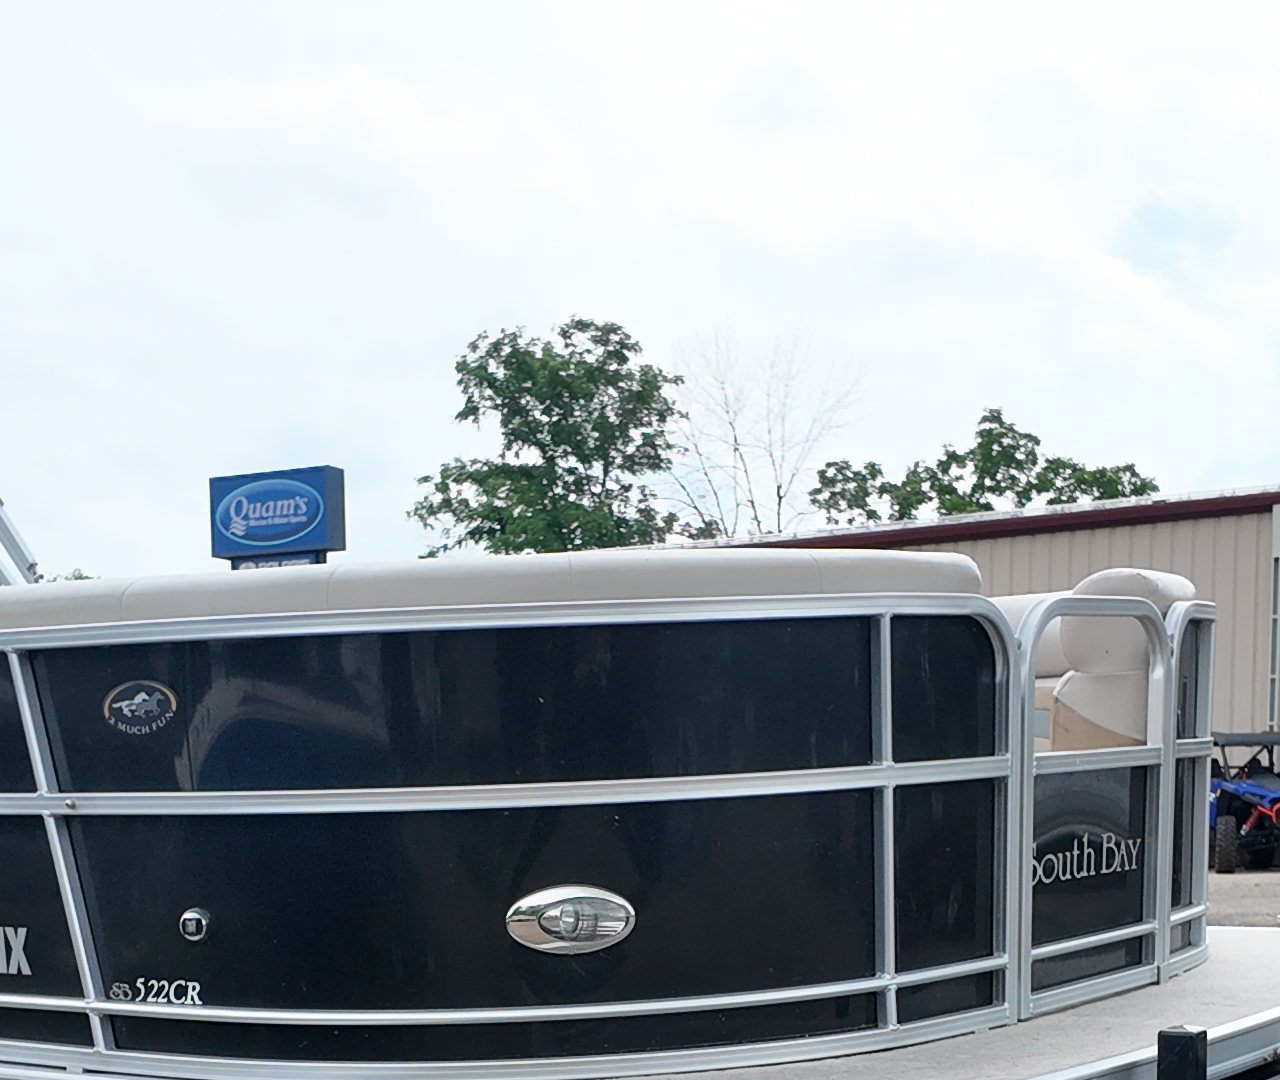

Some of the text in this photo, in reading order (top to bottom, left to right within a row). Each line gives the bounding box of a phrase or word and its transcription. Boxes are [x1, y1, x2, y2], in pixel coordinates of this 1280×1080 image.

[229, 496, 308, 524] Quam's
[117, 721, 150, 735] MUCH
[151, 709, 174, 731] FUN
[1100, 832, 1142, 874] BAY
[135, 977, 203, 1005] 522CR
